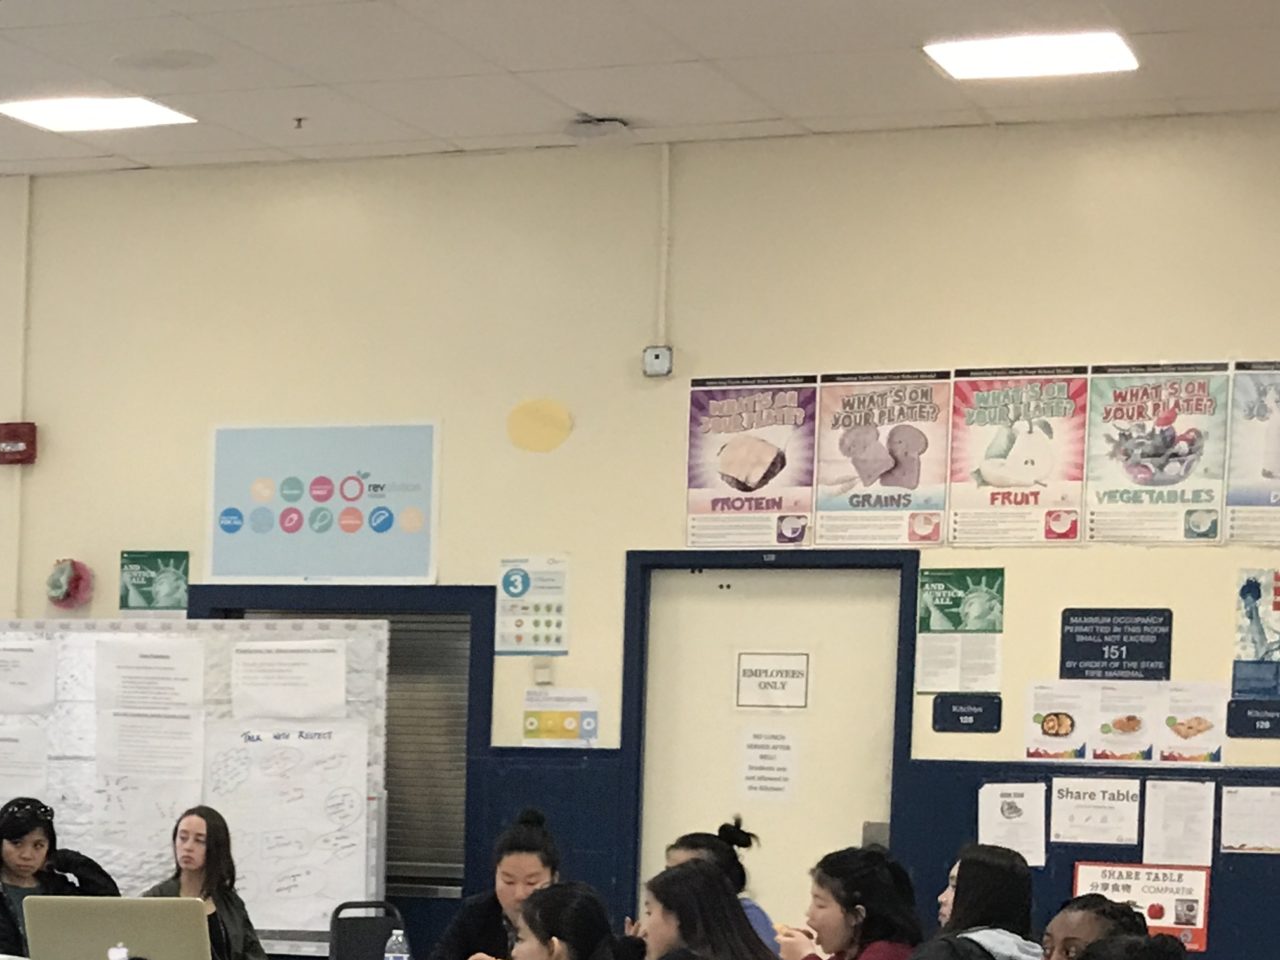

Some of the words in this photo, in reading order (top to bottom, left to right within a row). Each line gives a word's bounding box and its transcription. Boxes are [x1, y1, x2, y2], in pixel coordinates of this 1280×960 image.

[908, 387, 931, 402] ON
[1184, 381, 1207, 395] ON
[831, 412, 875, 428] YOUR
[878, 404, 939, 424] PLATE?
[1102, 403, 1148, 420] YOUR
[711, 497, 782, 511] PROTEIN
[849, 494, 912, 508] GRAINS
[990, 491, 1040, 506] FRUIT
[1096, 489, 1215, 505] VEGETABLES
[509, 575, 523, 594] 3
[1070, 616, 1111, 624] MAXIMUM
[1112, 616, 1164, 624] OCCUPANCY
[1064, 625, 1111, 634] PERMITTED
[1123, 626, 1141, 634] THIS
[1143, 626, 1169, 634] ROOM
[1075, 635, 1102, 643] SHALL
[1123, 635, 1157, 643] EXCEED
[1102, 645, 1127, 659] 151
[1123, 661, 1138, 669] THE
[742, 668, 805, 679] EMPLOYEES
[1104, 670, 1144, 678] MARSHAL
[758, 681, 788, 690] ONLY
[951, 705, 983, 713] Kitchen
[1057, 788, 1096, 801] Share
[1100, 789, 1139, 803] Table
[1101, 869, 1141, 880] SHARE
[1145, 872, 1185, 883] TABLE
[1141, 884, 1195, 896] COMPARTIR
